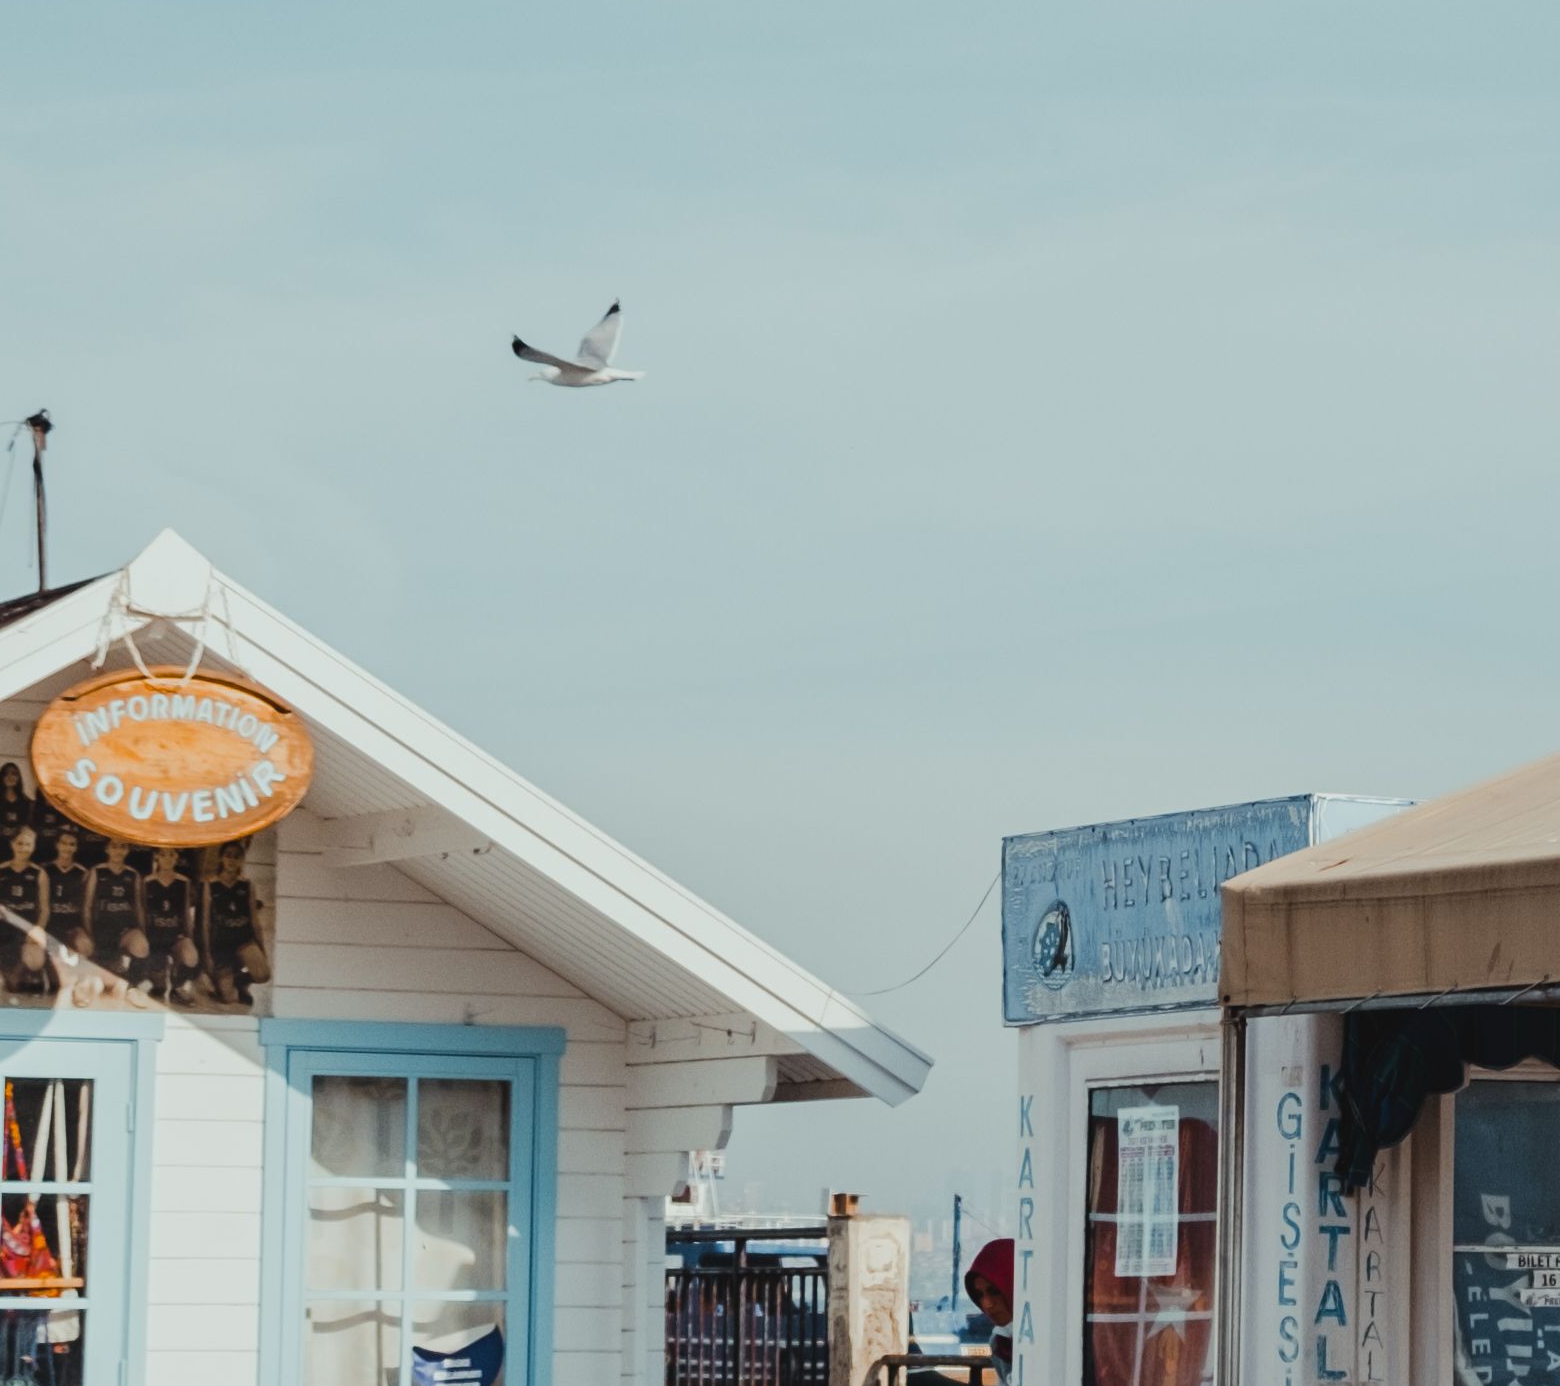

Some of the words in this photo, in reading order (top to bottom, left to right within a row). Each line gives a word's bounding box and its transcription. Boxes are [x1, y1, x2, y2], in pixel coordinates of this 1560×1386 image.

[1314, 1064, 1351, 1381] KARTAL
[1362, 1162, 1386, 1383] KARTAL
[1542, 1273, 1557, 1287] 16
